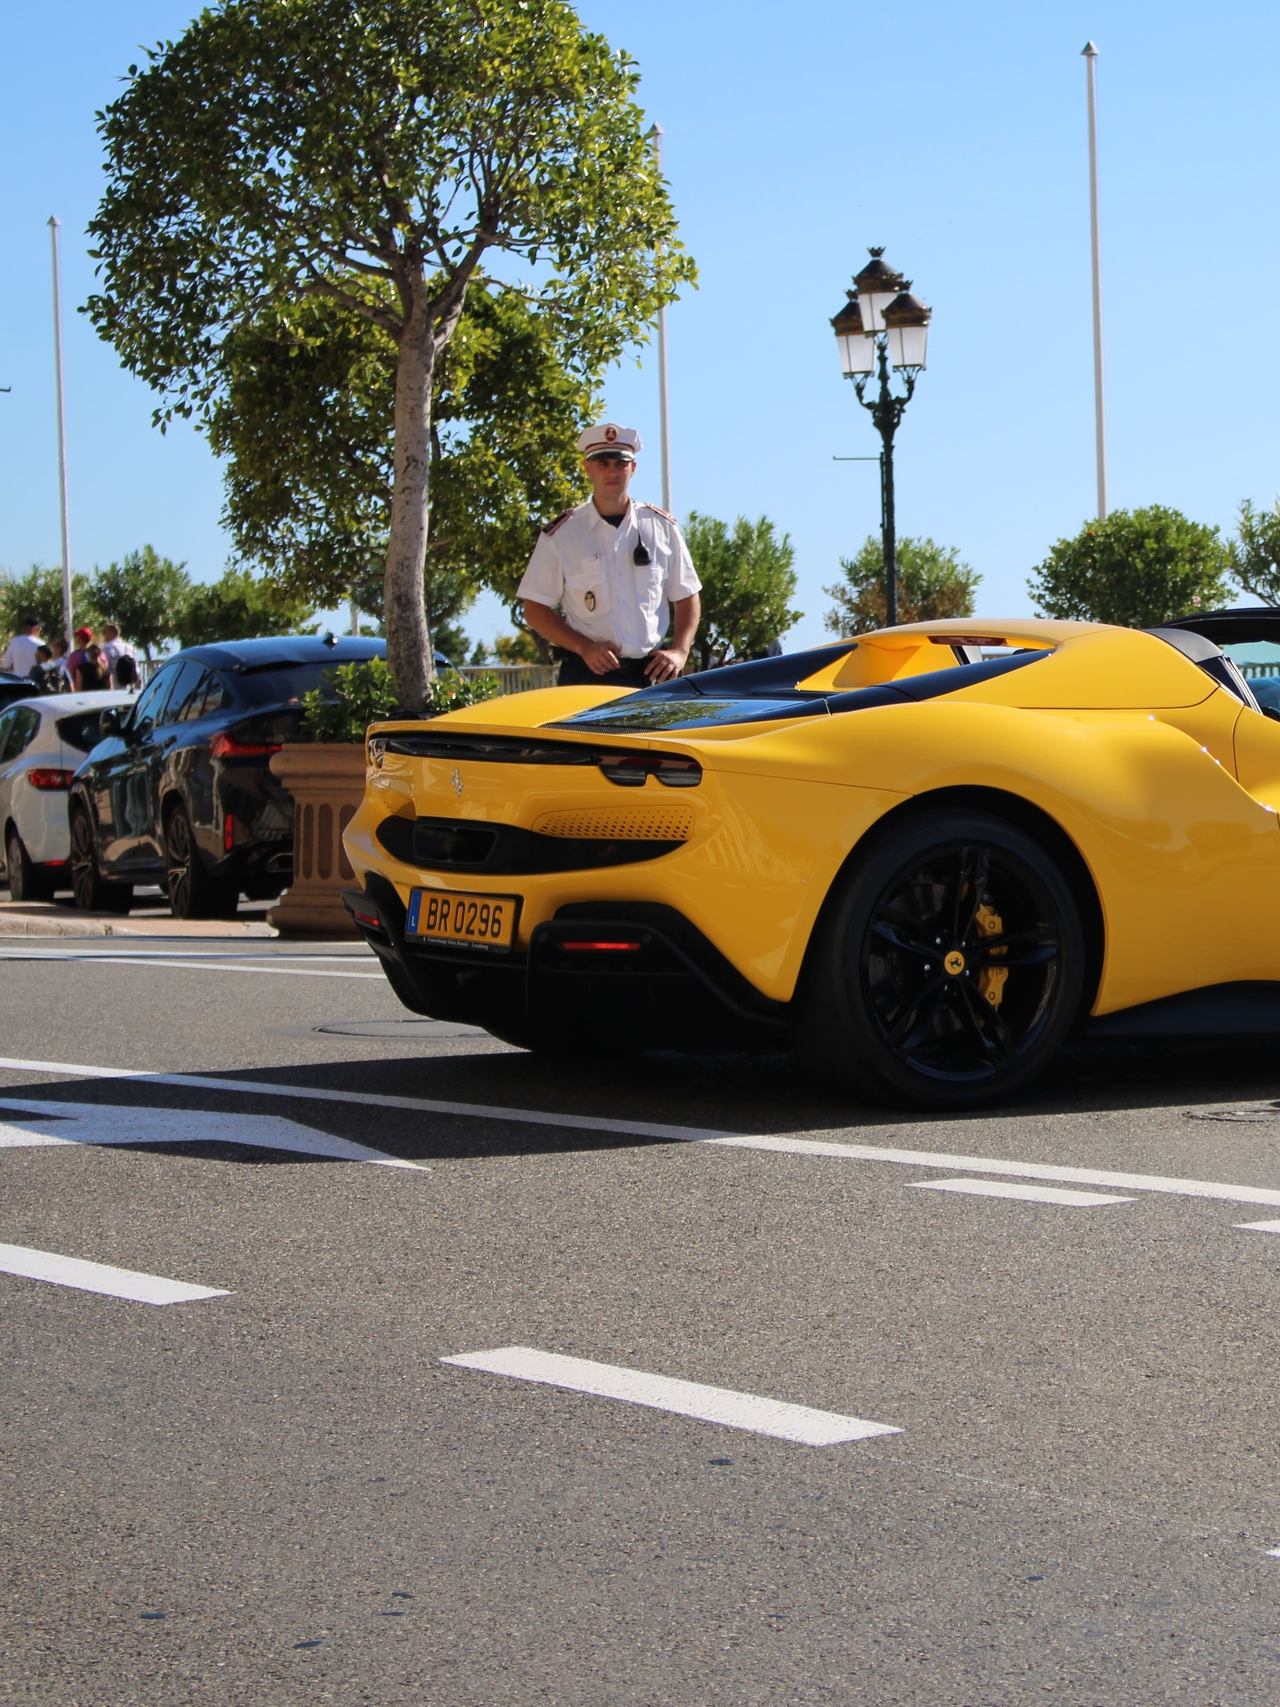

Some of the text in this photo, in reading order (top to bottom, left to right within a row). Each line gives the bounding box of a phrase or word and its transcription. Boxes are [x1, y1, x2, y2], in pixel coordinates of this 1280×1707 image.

[411, 915, 416, 927] L
[426, 897, 503, 939] BR 0296
